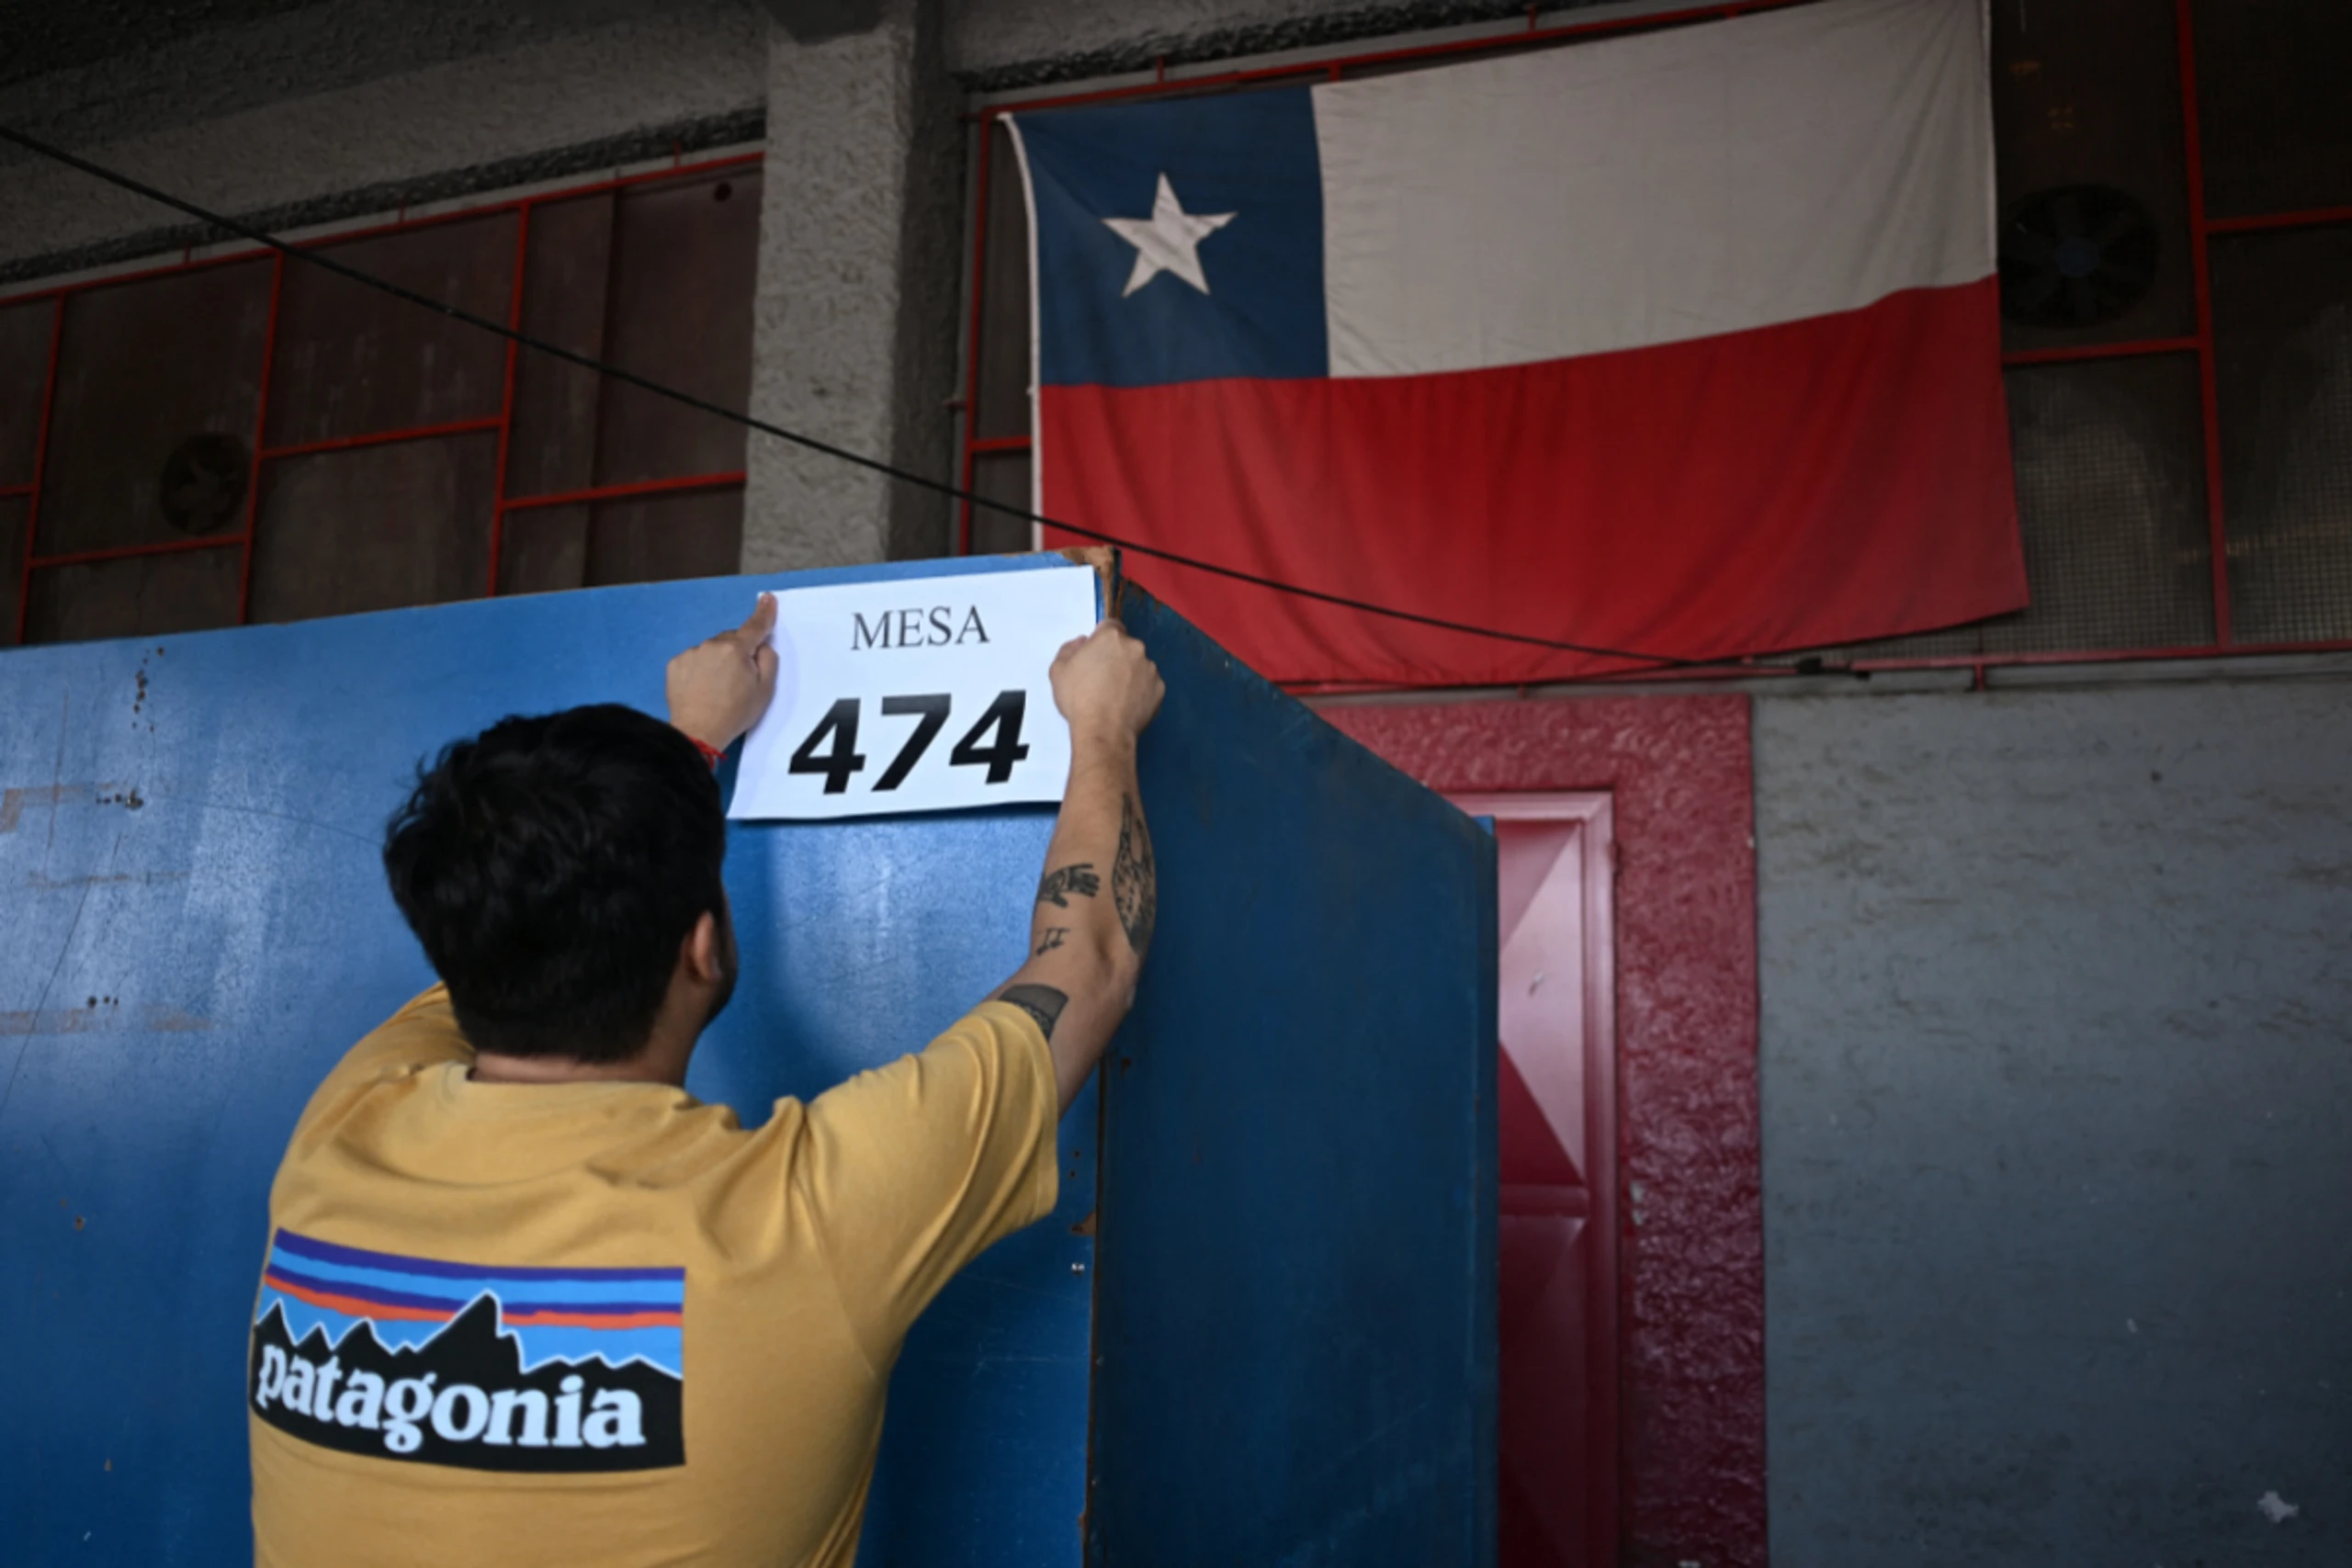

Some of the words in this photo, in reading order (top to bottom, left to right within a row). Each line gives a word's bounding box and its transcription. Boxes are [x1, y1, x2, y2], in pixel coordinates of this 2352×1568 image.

[851, 605, 989, 649] MESA
[788, 690, 1030, 795] 474
[257, 1344, 646, 1453] patagonia
